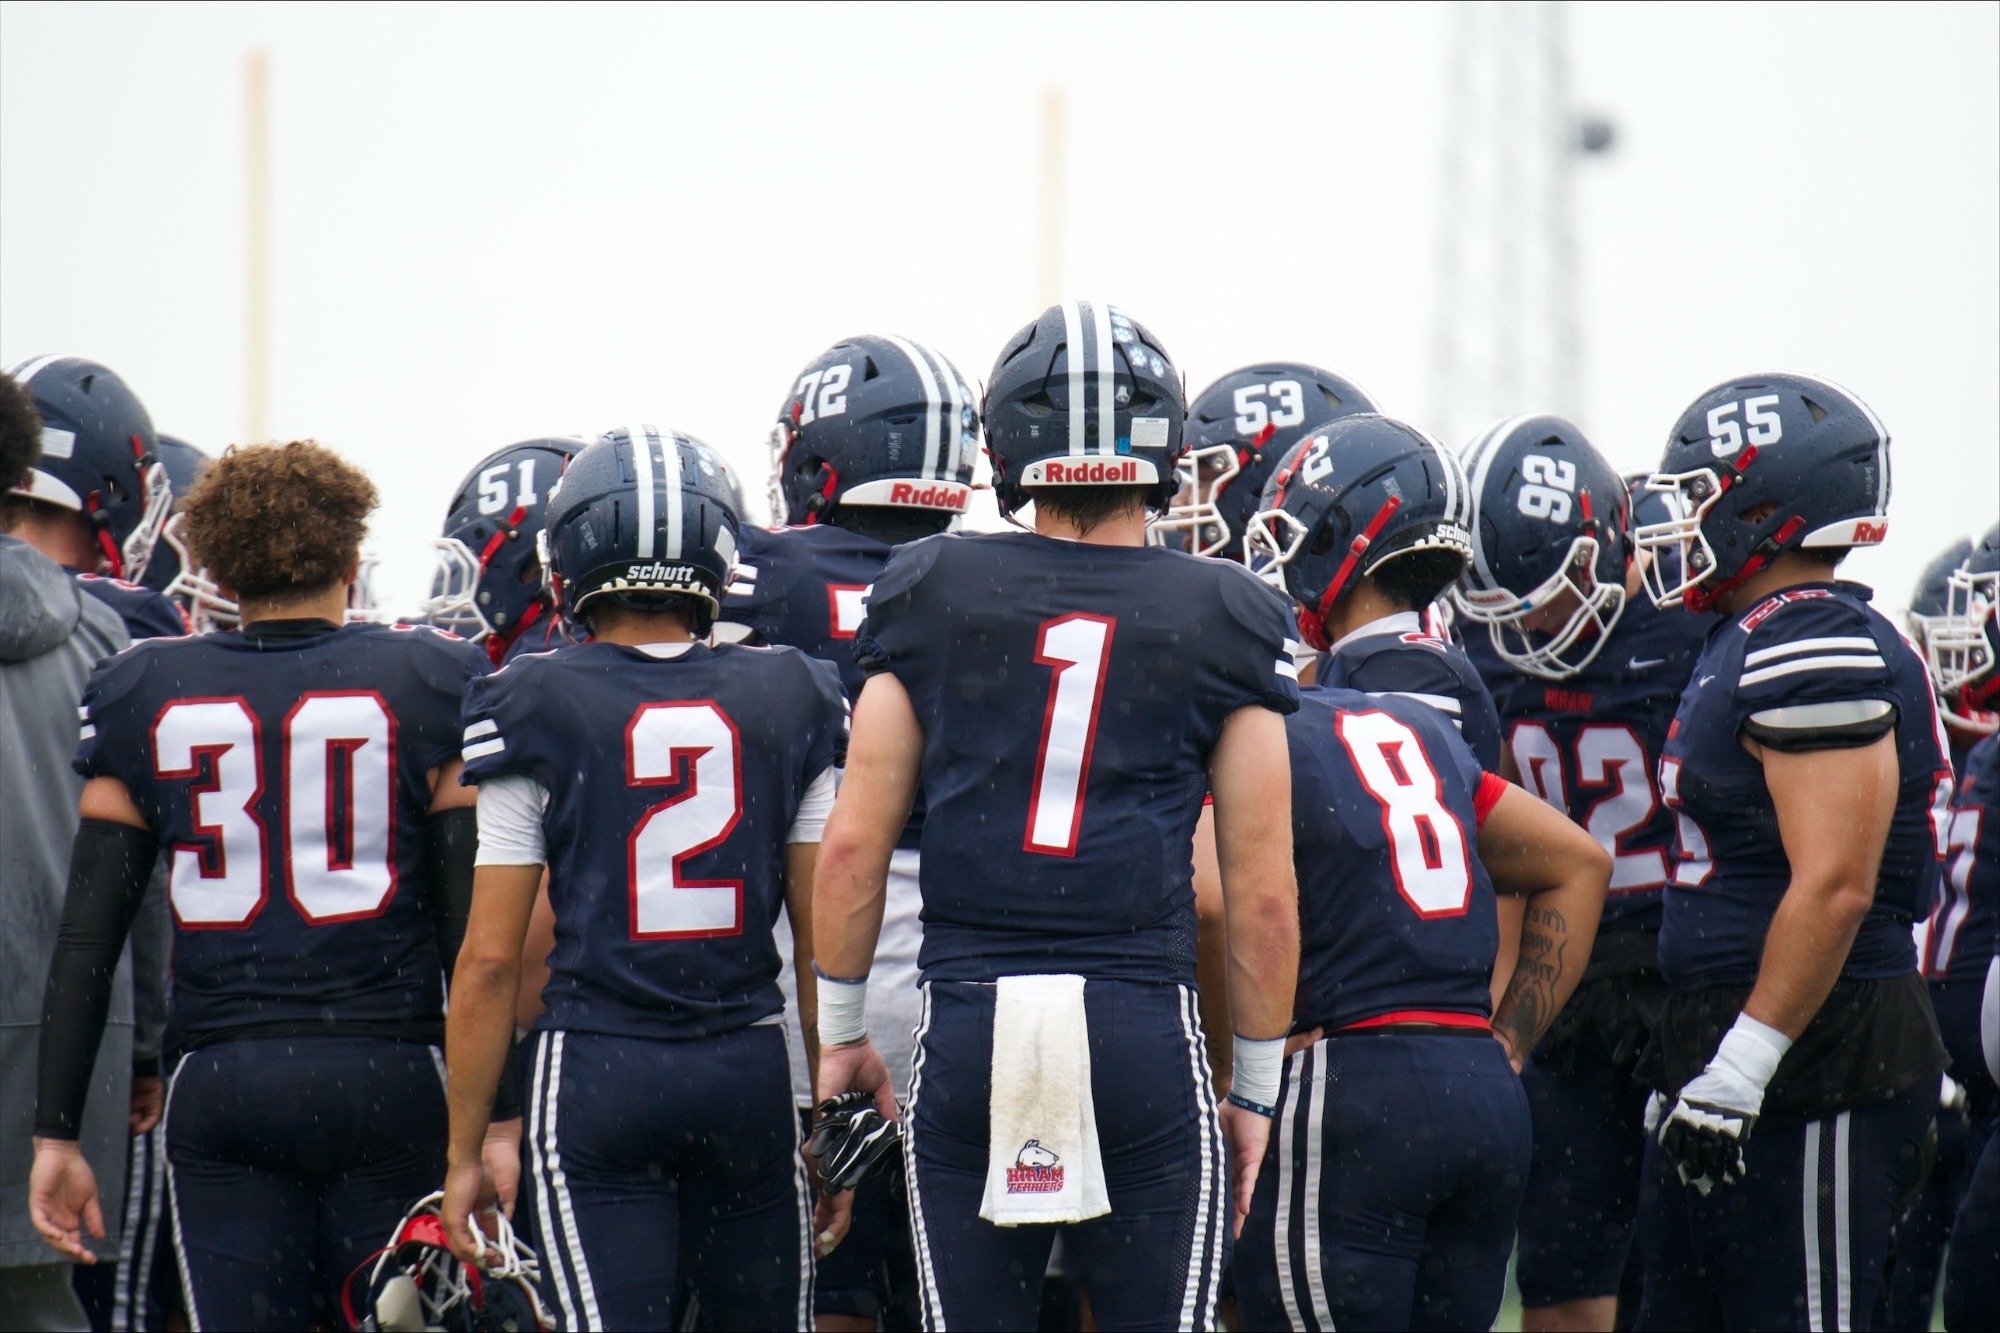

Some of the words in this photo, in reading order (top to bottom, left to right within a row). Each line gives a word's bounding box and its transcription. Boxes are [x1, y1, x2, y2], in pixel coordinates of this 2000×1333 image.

[797, 363, 853, 425] 72
[1232, 379, 1305, 435] 53
[1706, 394, 1783, 458] 55
[477, 458, 538, 515] 51
[1045, 461, 1137, 483] Riddell
[1517, 454, 1577, 526] 92
[626, 561, 695, 582] schutt
[1023, 610, 1118, 858] 1
[149, 688, 399, 930] 30
[623, 699, 743, 941] 2
[1335, 707, 1473, 918] 8
[1006, 1165, 1064, 1183] HIRAM
[1007, 1181, 1064, 1194] TERRIERS
